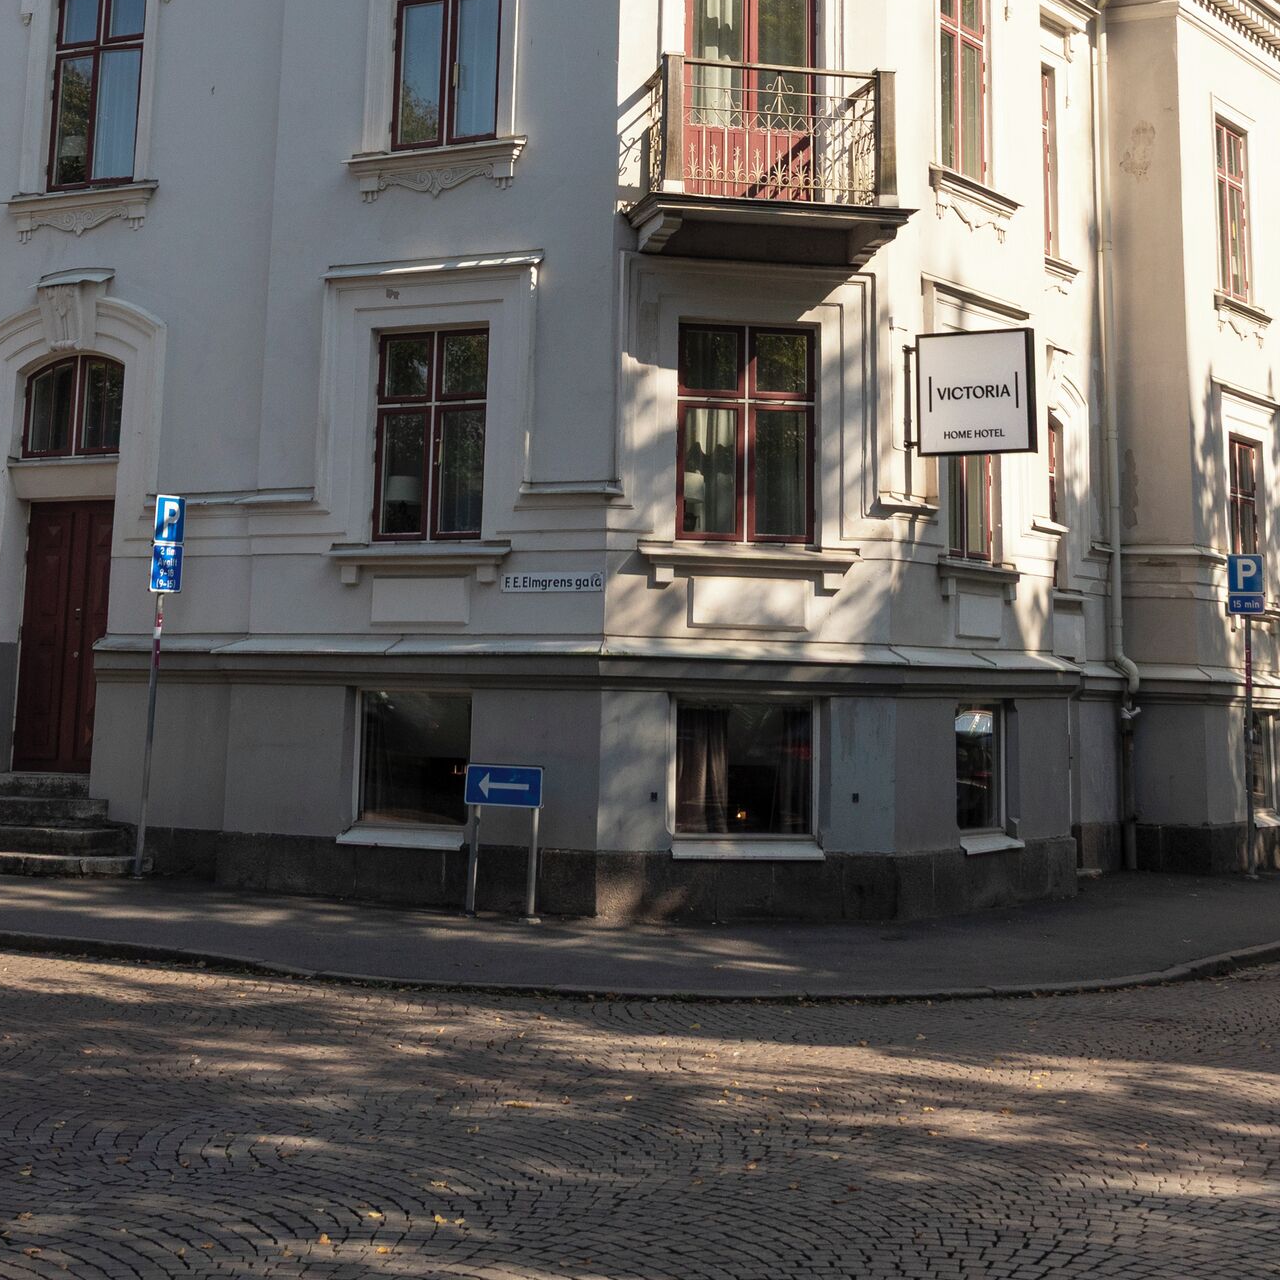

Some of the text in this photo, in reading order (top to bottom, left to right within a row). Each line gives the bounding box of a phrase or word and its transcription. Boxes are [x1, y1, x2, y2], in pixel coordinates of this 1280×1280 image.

[937, 384, 1011, 400] VICTORIA
[943, 428, 1006, 439] HOME HOTEL
[162, 501, 180, 538] P
[160, 547, 165, 555] 2
[1237, 559, 1257, 589] P
[1233, 600, 1260, 608] 15 min
